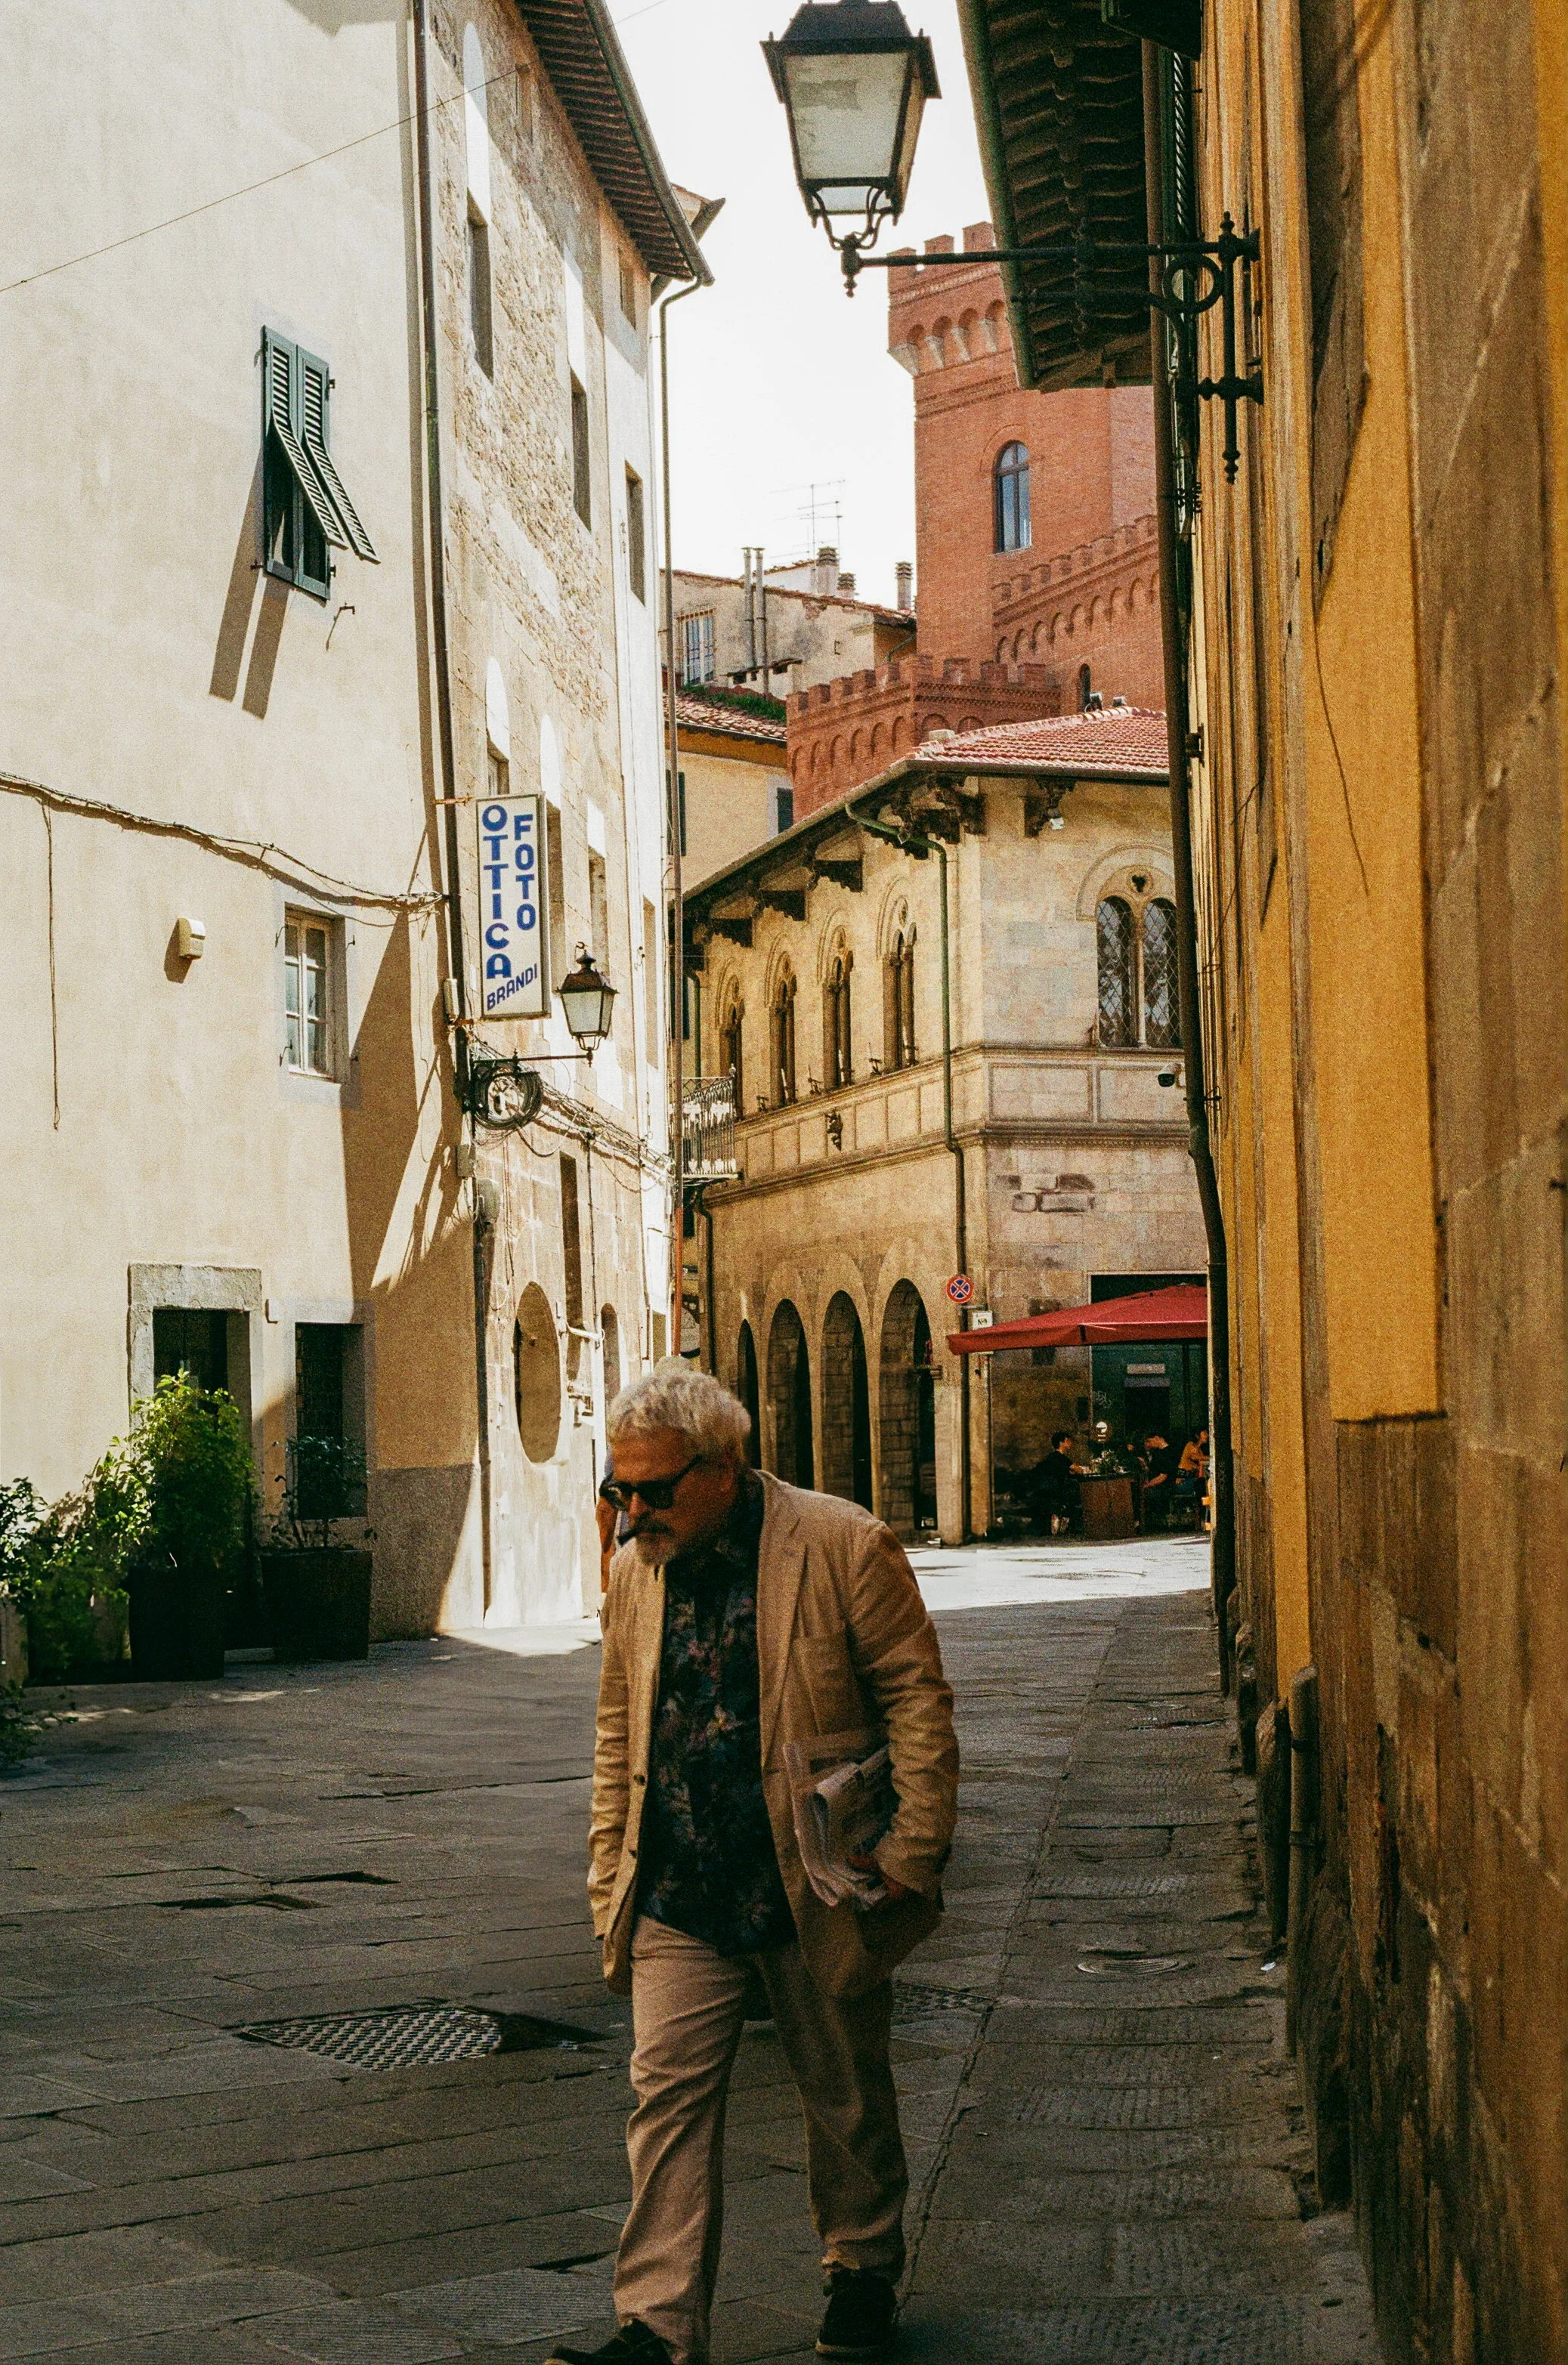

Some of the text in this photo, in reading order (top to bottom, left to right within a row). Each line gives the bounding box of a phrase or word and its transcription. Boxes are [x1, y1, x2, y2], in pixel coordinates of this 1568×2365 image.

[482, 805, 512, 979] OTTICA
[514, 814, 536, 930] FOTO
[487, 963, 537, 1011] BRANDI
